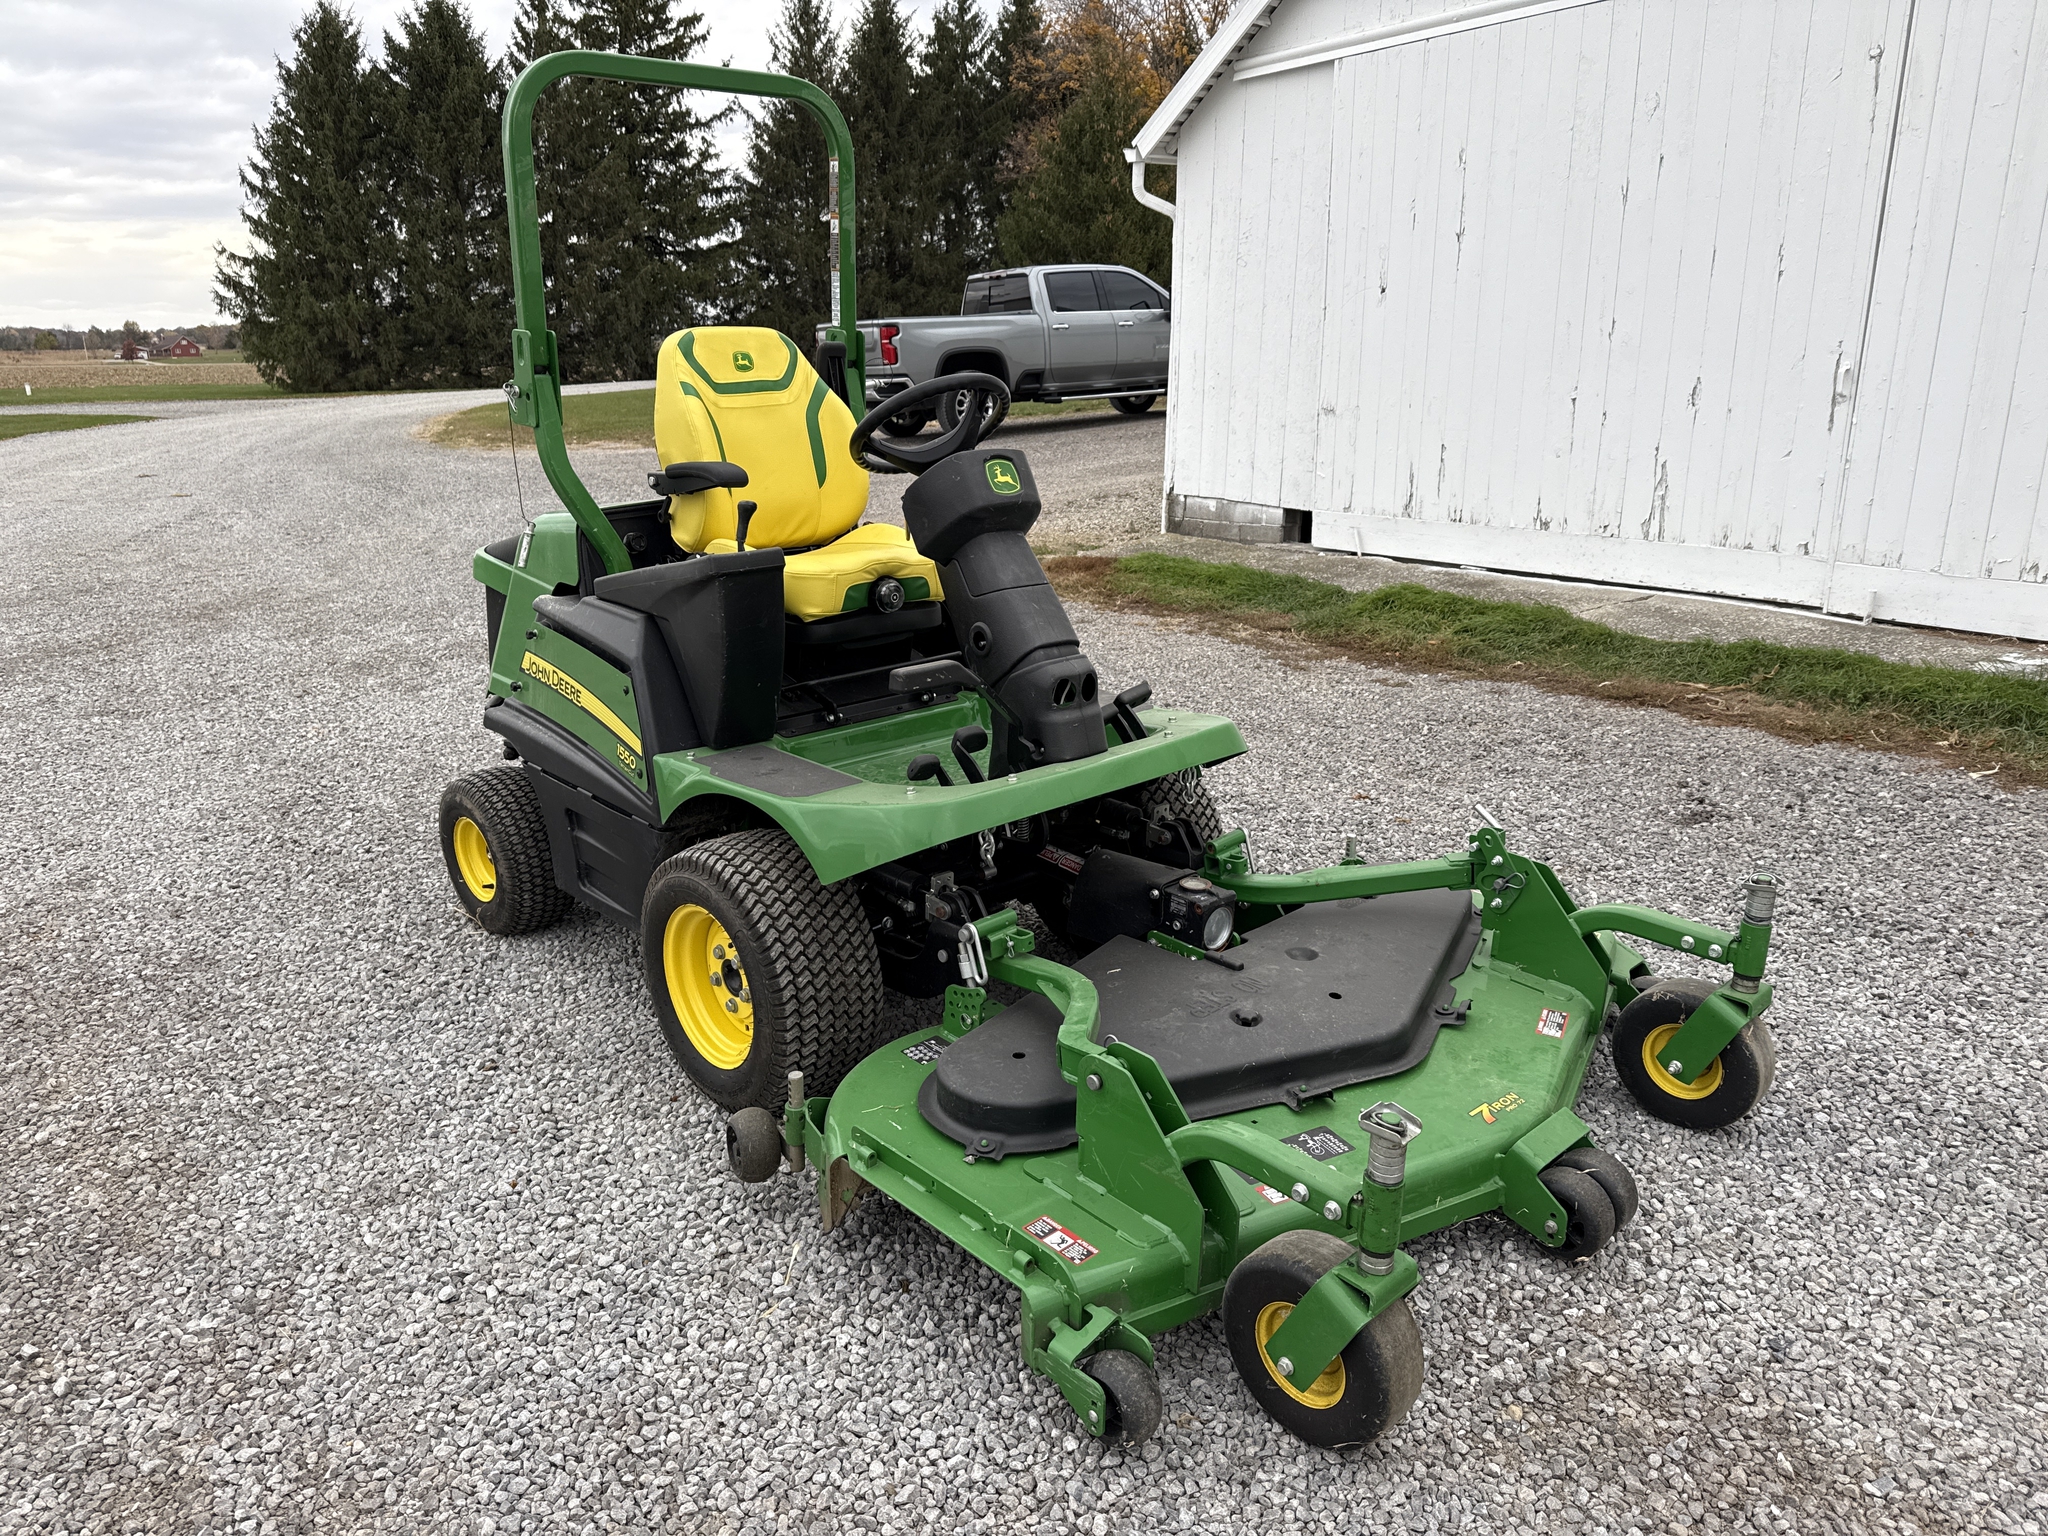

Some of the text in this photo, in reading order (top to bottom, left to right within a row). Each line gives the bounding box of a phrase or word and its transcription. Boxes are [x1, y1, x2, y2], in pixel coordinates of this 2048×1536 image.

[525, 656, 582, 705] JOHN DEERE
[616, 743, 637, 770] 1550
[1488, 1092, 1520, 1113] IRON
